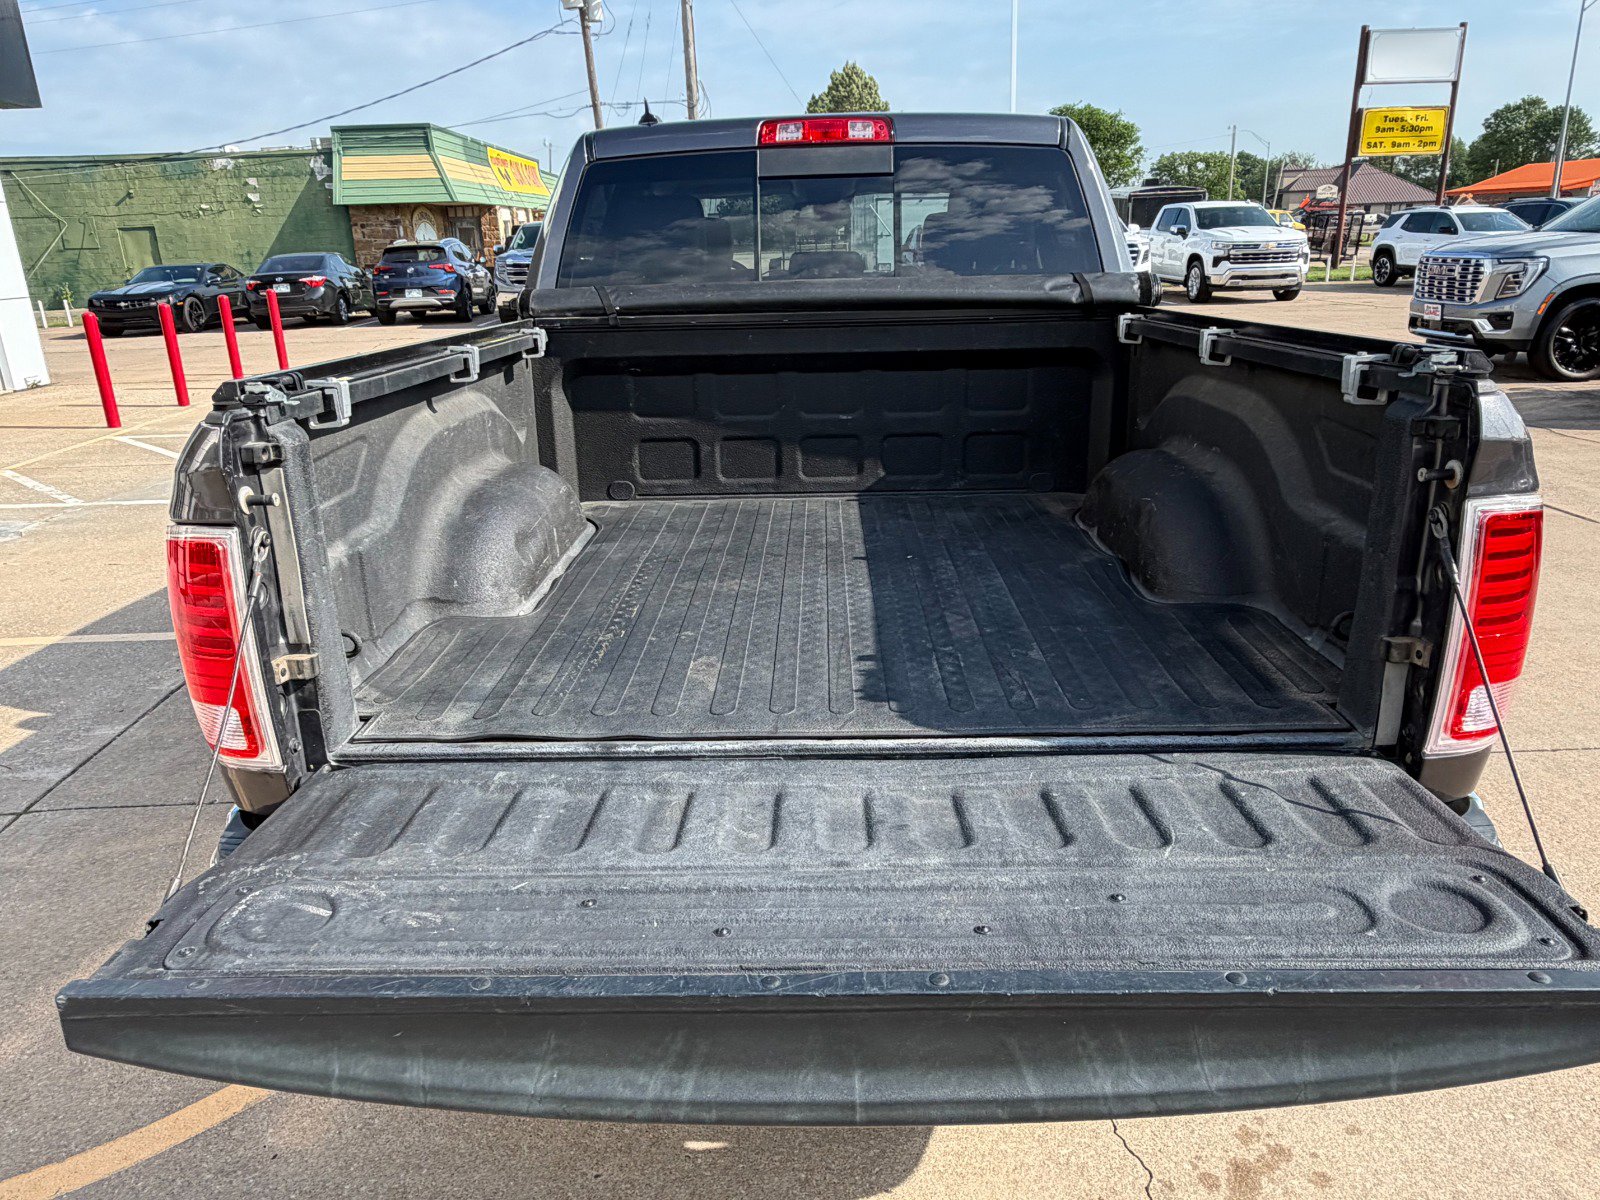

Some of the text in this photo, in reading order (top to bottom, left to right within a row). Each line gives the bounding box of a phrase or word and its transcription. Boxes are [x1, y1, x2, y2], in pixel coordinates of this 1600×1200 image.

[1384, 115, 1407, 123] Tues.
[1400, 125, 1433, 134] 5:30pm
[1366, 141, 1386, 149] SAT.
[1391, 140, 1410, 148] 9am
[1417, 140, 1436, 148] 2pm
[1428, 265, 1455, 276] GMC
